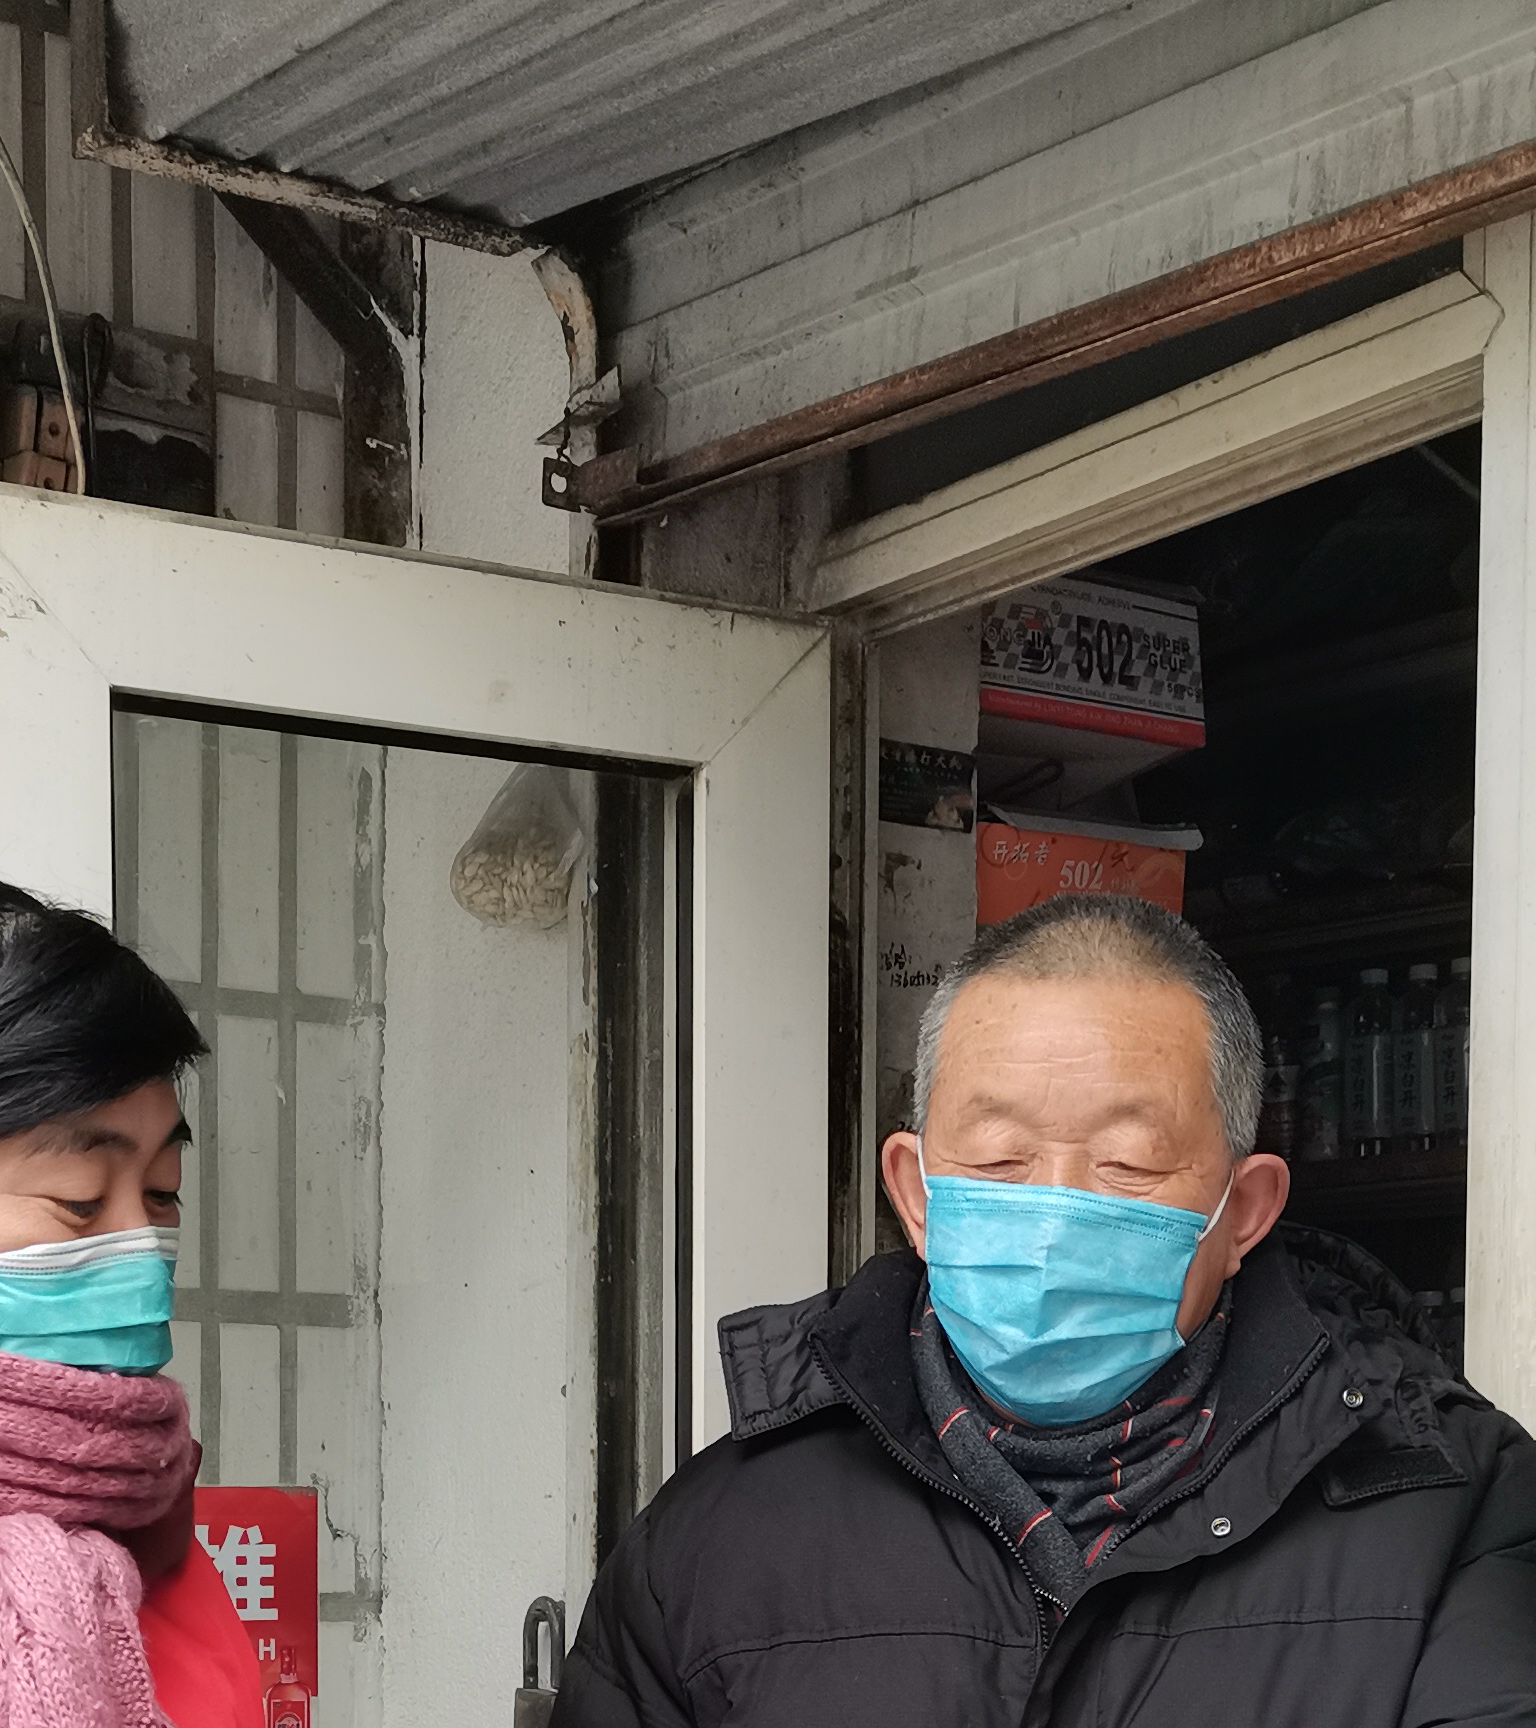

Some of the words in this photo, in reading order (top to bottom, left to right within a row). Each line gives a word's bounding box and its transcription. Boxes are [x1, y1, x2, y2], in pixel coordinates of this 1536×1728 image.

[1076, 614, 1136, 687] 502
[1142, 633, 1191, 656] SUPER
[1148, 652, 1188, 674] GLUE
[1059, 859, 1104, 890] 502
